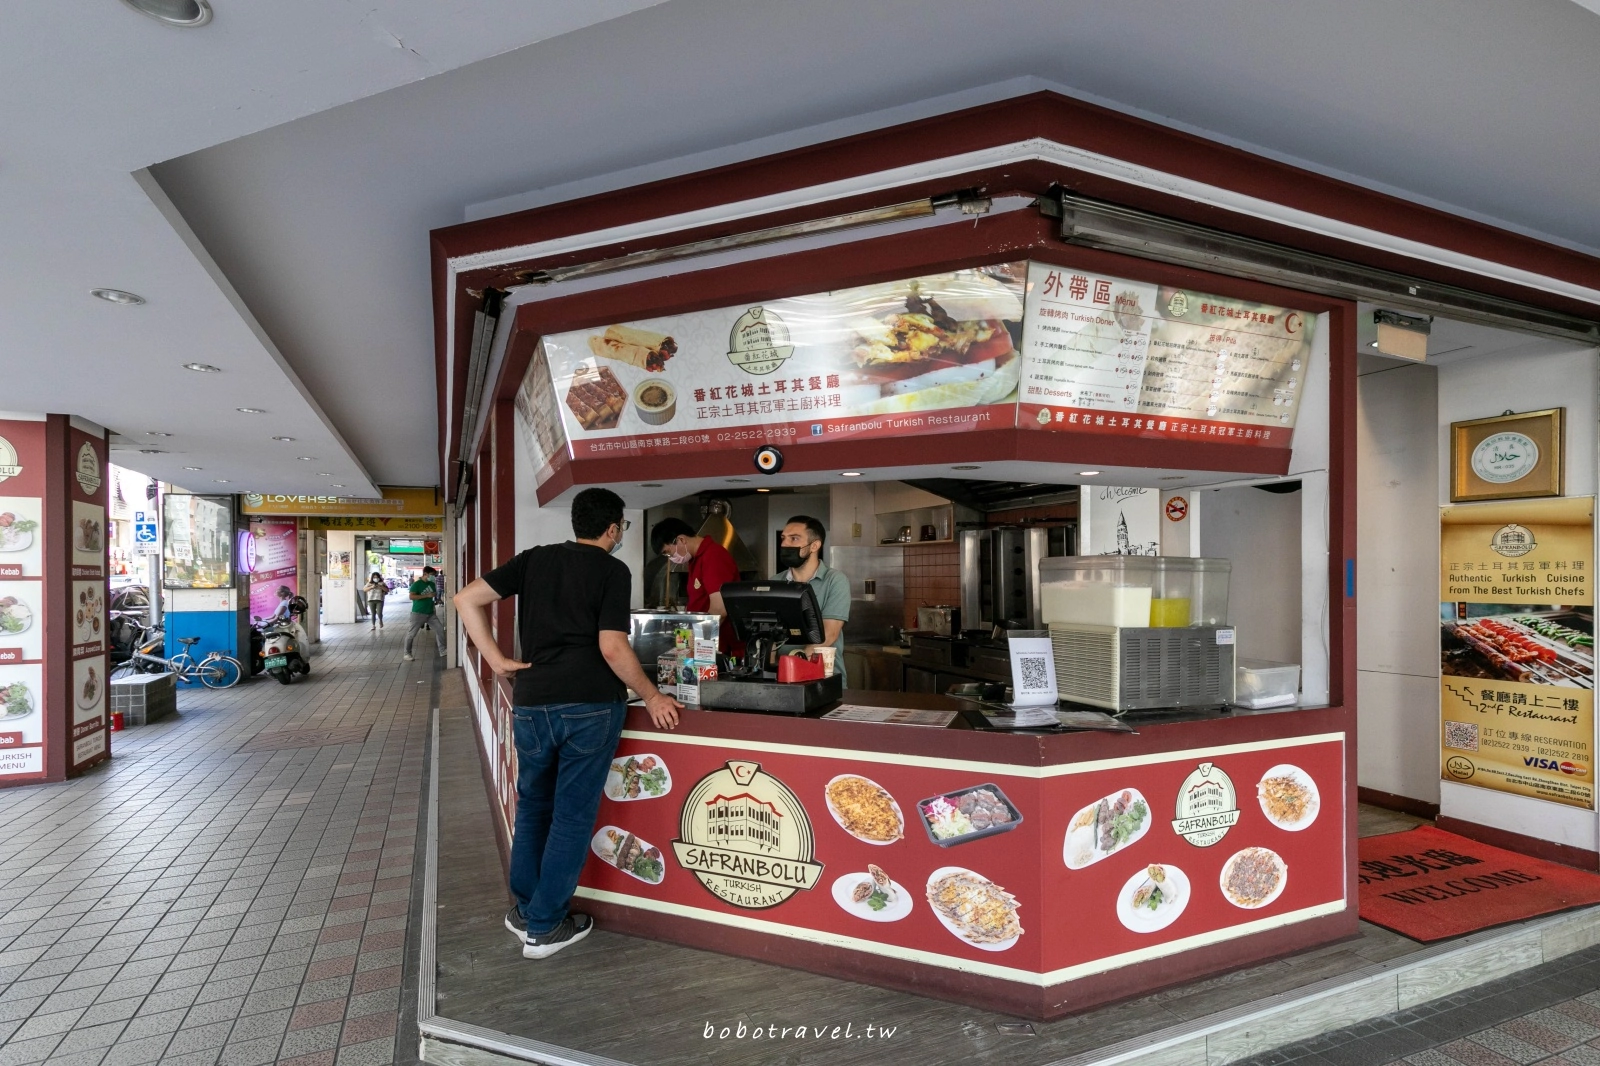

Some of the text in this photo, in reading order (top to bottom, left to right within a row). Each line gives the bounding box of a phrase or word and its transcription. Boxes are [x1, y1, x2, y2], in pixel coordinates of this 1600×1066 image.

[1043, 271, 1113, 305] 外帶區
[1115, 295, 1136, 307] Menu
[1039, 307, 1069, 321] 旋轉烤肉
[1070, 312, 1095, 324] Turkish
[1201, 303, 1275, 325] 番紅花城土耳其餐廳
[744, 349, 779, 361] 番紅花城
[694, 374, 840, 402] 番紅花城土耳其餐廳
[1028, 386, 1072, 397] 甜點 Desserts
[696, 393, 842, 419] 正宗土耳其冠軍主廚料理
[827, 421, 882, 433] Safranbolu
[886, 417, 924, 428] Turkish
[928, 412, 990, 425] Restaurant
[1055, 412, 1271, 440] 番紅花城土耳其餐廳 正宗土耳其冠軍主廚料理
[717, 428, 796, 441] 02-2522-2939
[137, 512, 143, 521] P
[1, 568, 19, 576] Kebab
[1449, 561, 1585, 571] 正宗土耳其冠軍料理
[1449, 573, 1585, 582] Authentic Turkish Cuisine
[1473, 586, 1488, 595] The
[1492, 586, 1512, 595] Best
[1516, 586, 1551, 596] Turkish
[1555, 586, 1585, 596] Chefs
[1481, 689, 1579, 711] 餐廳請上二樓
[1508, 706, 1577, 724] Restaurant
[1483, 727, 1587, 750] 訂位專線 RESERVATION
[1512, 742, 1530, 753] 2939
[1572, 752, 1589, 762] 2819
[1523, 756, 1559, 771] VISA
[1560, 764, 1587, 773] MasterCard
[1178, 813, 1234, 832] SAFRANBOLU
[1189, 830, 1225, 845] RESTAURANT
[686, 848, 806, 884] SAFRANBOLU
[705, 878, 784, 906] RESTAURANT
[723, 879, 762, 893] TURKISH
[1379, 869, 1543, 905] WELCOME
